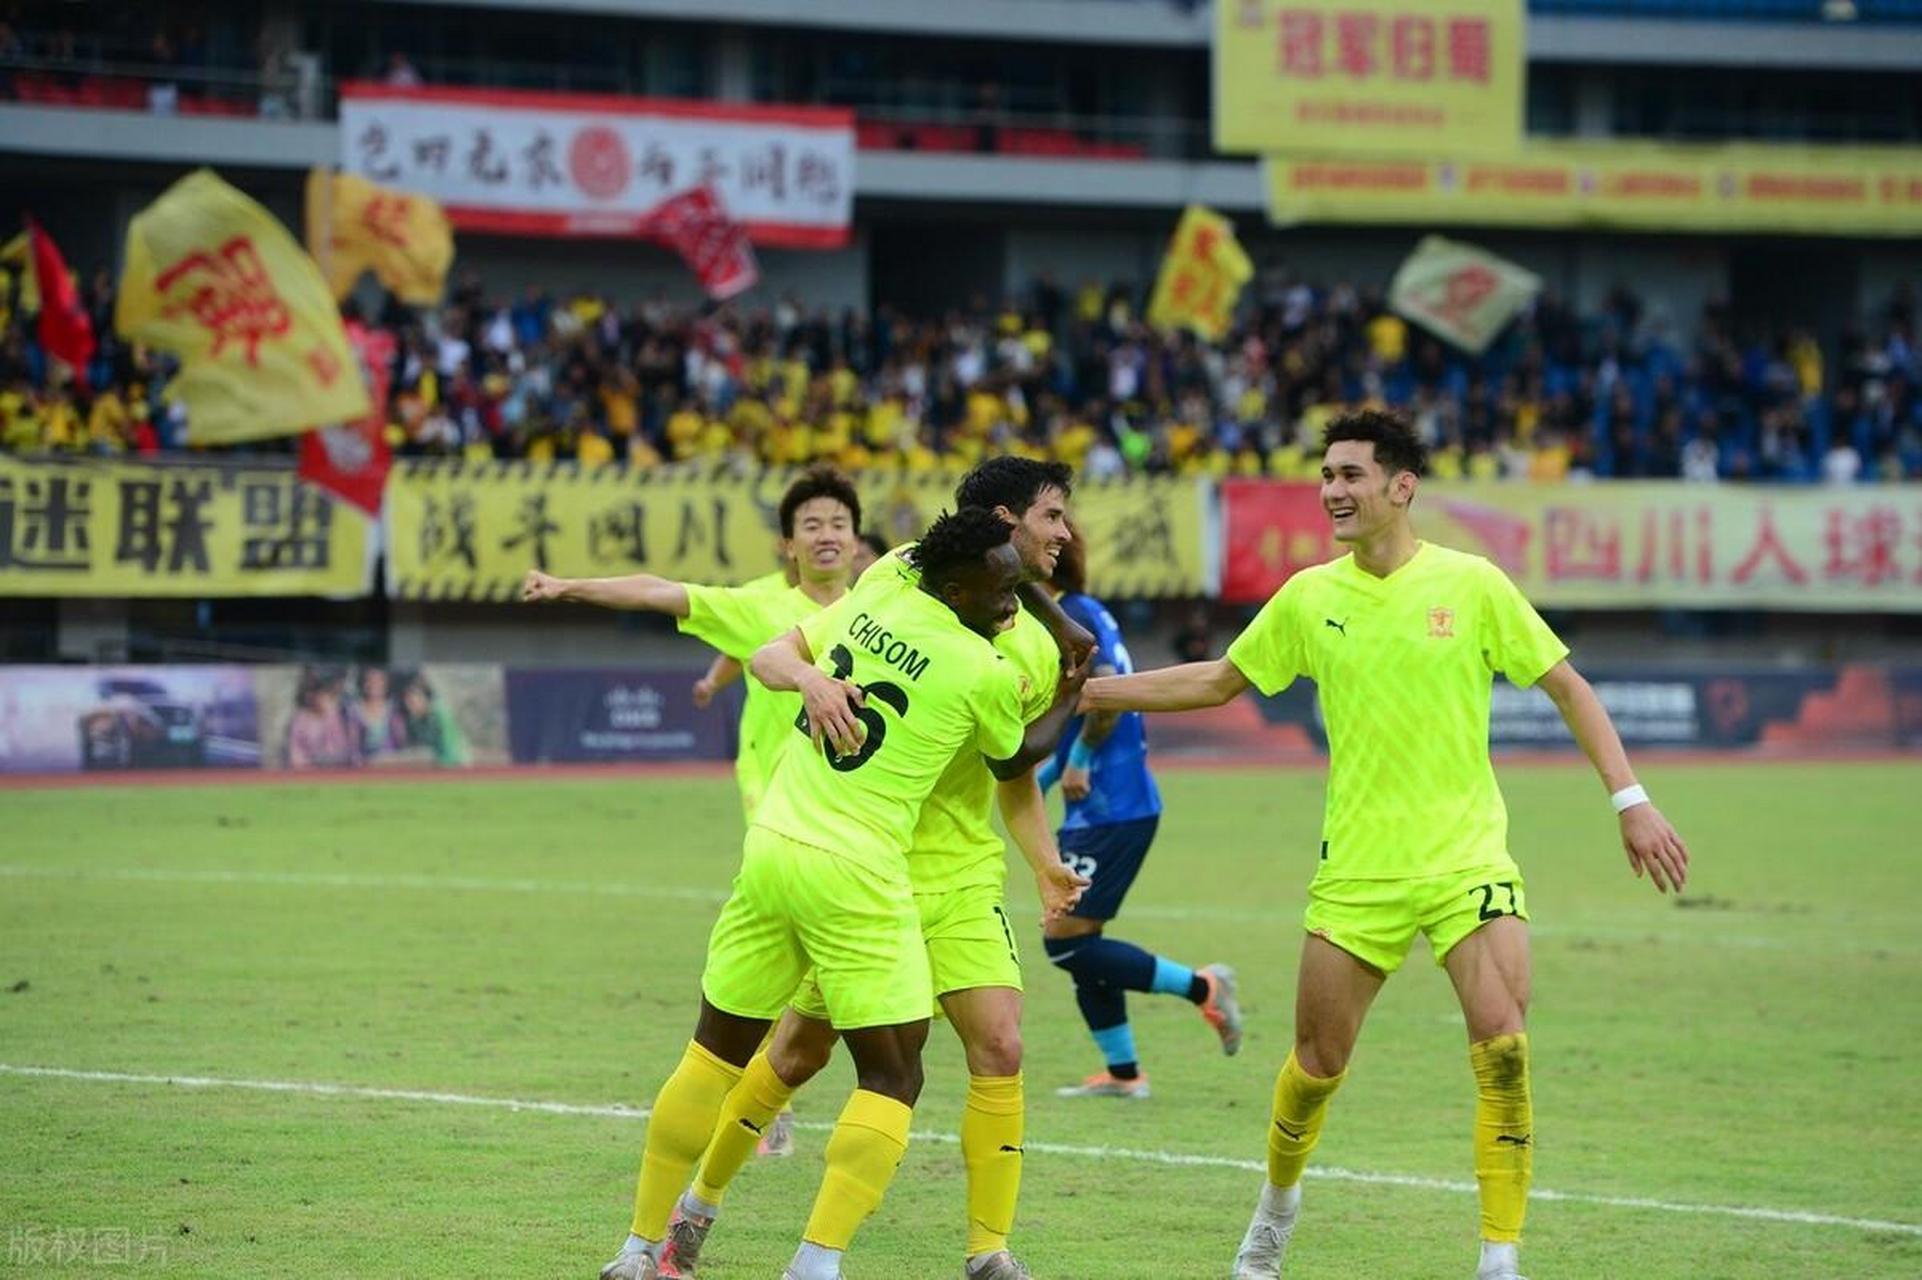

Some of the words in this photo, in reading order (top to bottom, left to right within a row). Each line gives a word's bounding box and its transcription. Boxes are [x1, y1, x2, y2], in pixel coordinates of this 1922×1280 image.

[0, 474, 333, 573] 迷联盟
[1546, 503, 1922, 586] 四川人球
[849, 612, 931, 682] CHISOM
[1469, 881, 1519, 922] 27
